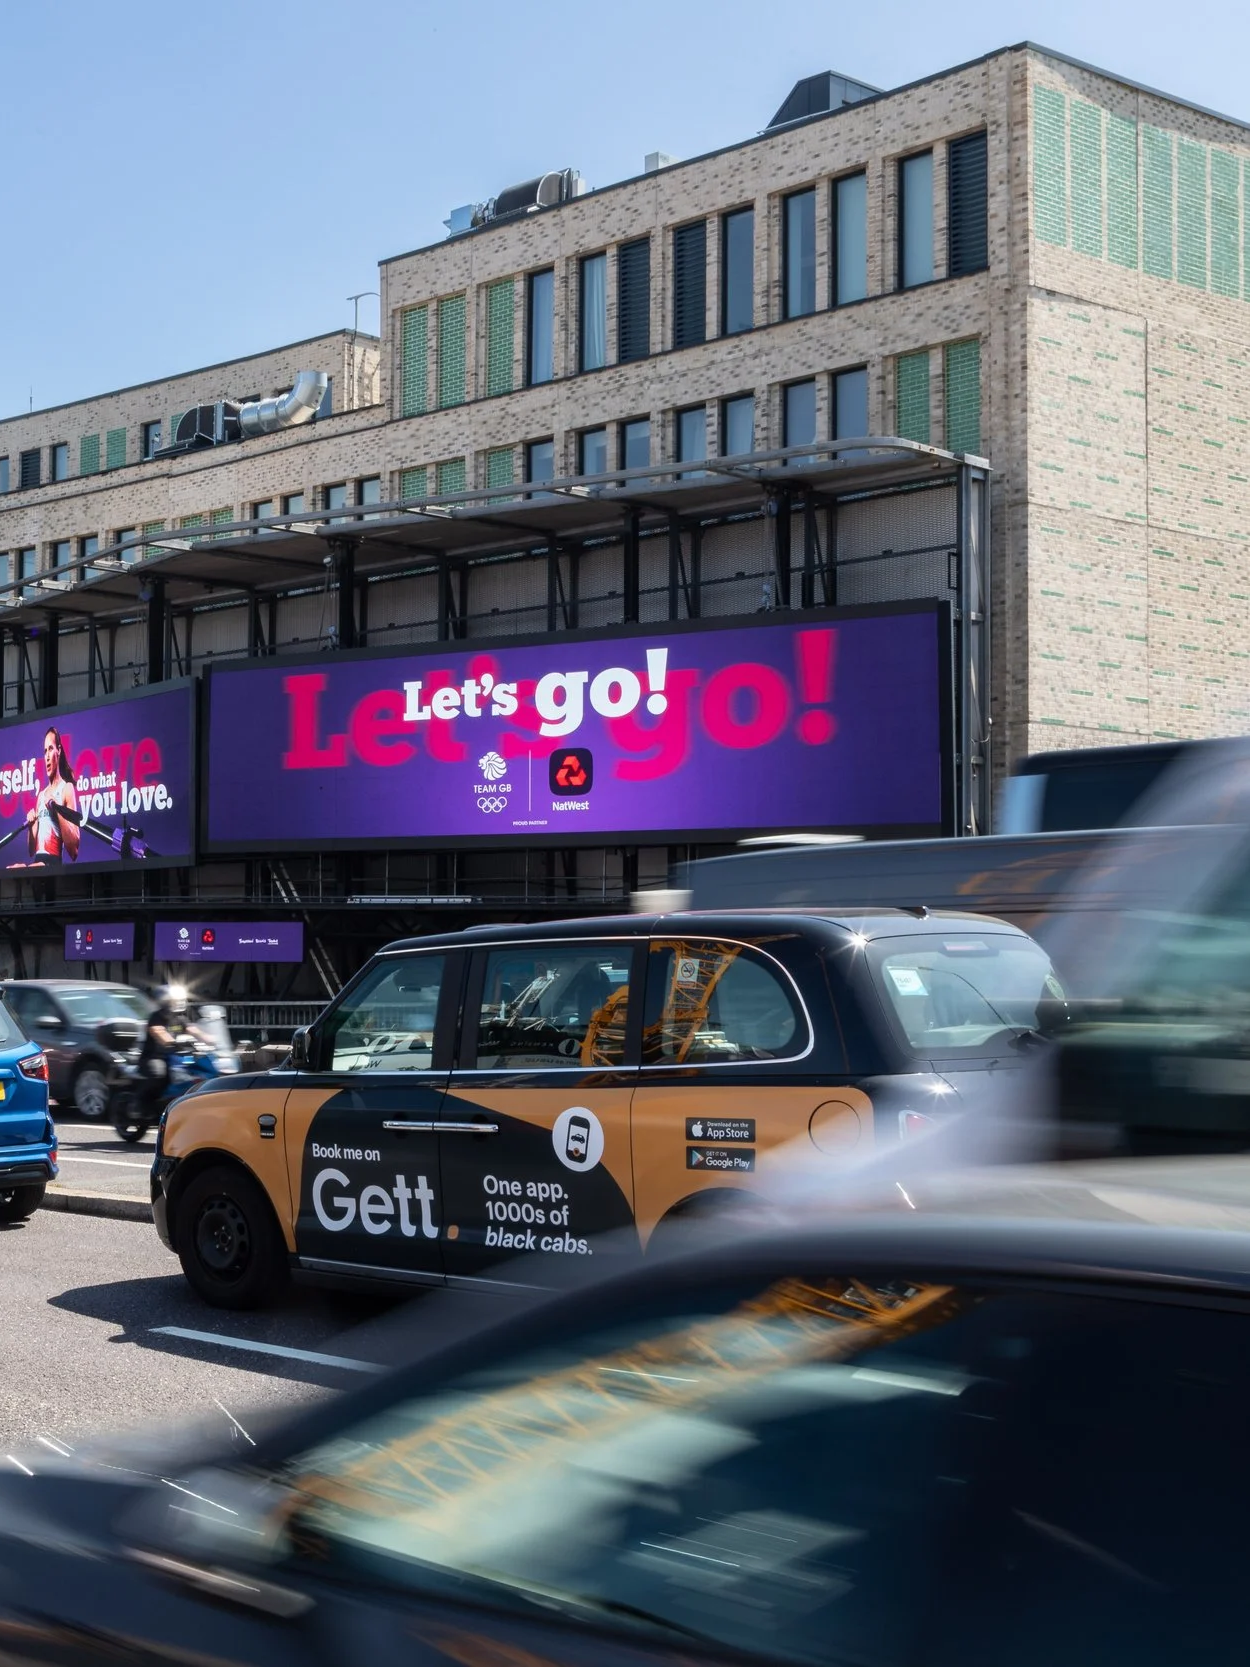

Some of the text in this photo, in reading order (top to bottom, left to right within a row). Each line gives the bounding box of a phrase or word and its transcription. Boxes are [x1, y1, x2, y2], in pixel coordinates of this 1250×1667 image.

[403, 648, 668, 737] Let's go!
[77, 771, 116, 791] do what
[474, 784, 511, 793] TEAM GB
[79, 781, 172, 827] you love.
[553, 801, 589, 811] NatWest
[707, 1128, 749, 1139] App Store
[312, 1143, 381, 1161] Book me on
[706, 1157, 750, 1169] Google Play
[483, 1175, 569, 1201] One app.
[485, 1201, 570, 1226] 1000s of
[485, 1226, 593, 1255] black cabs.
